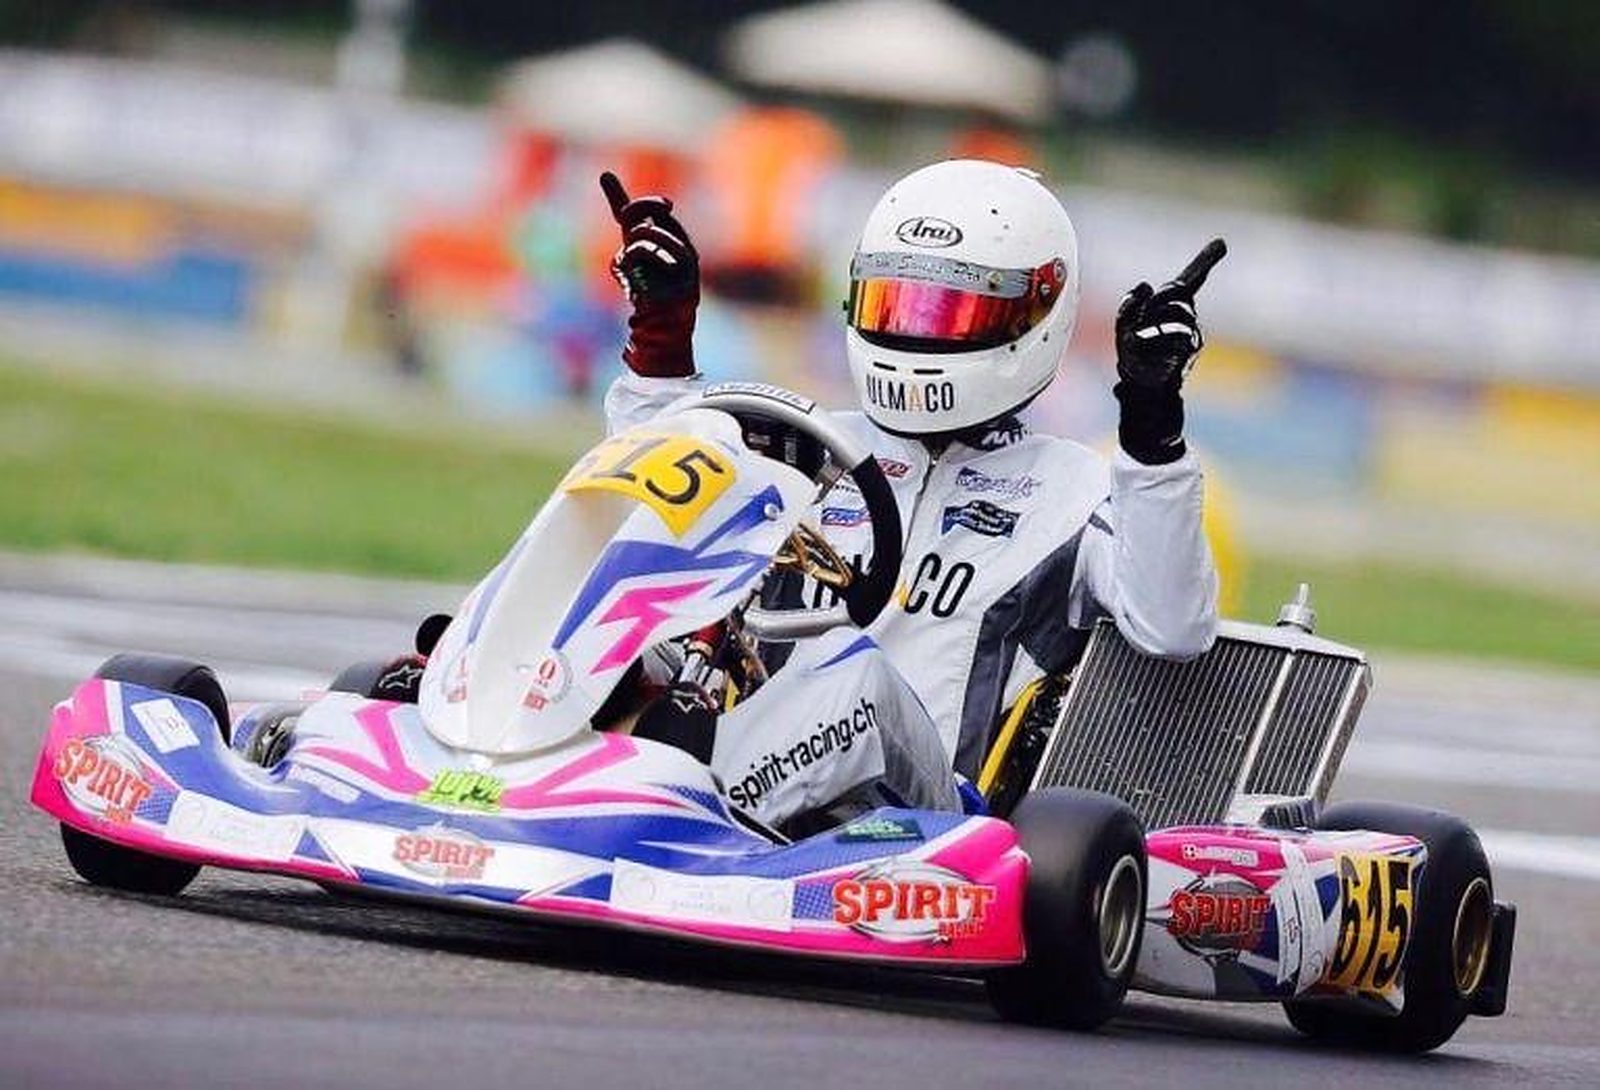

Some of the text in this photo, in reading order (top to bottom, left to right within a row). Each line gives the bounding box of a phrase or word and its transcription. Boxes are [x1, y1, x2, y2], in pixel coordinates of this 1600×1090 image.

[911, 217, 952, 241] Arai
[866, 374, 955, 412] ULMACO
[54, 739, 153, 812] SPIRIT
[729, 697, 878, 809] spirit-racing.ch
[391, 834, 495, 868] SPIRIT
[832, 879, 994, 926] SPIRIT
[1167, 890, 1271, 938] SPIRIT
[1332, 854, 1414, 990] 615
